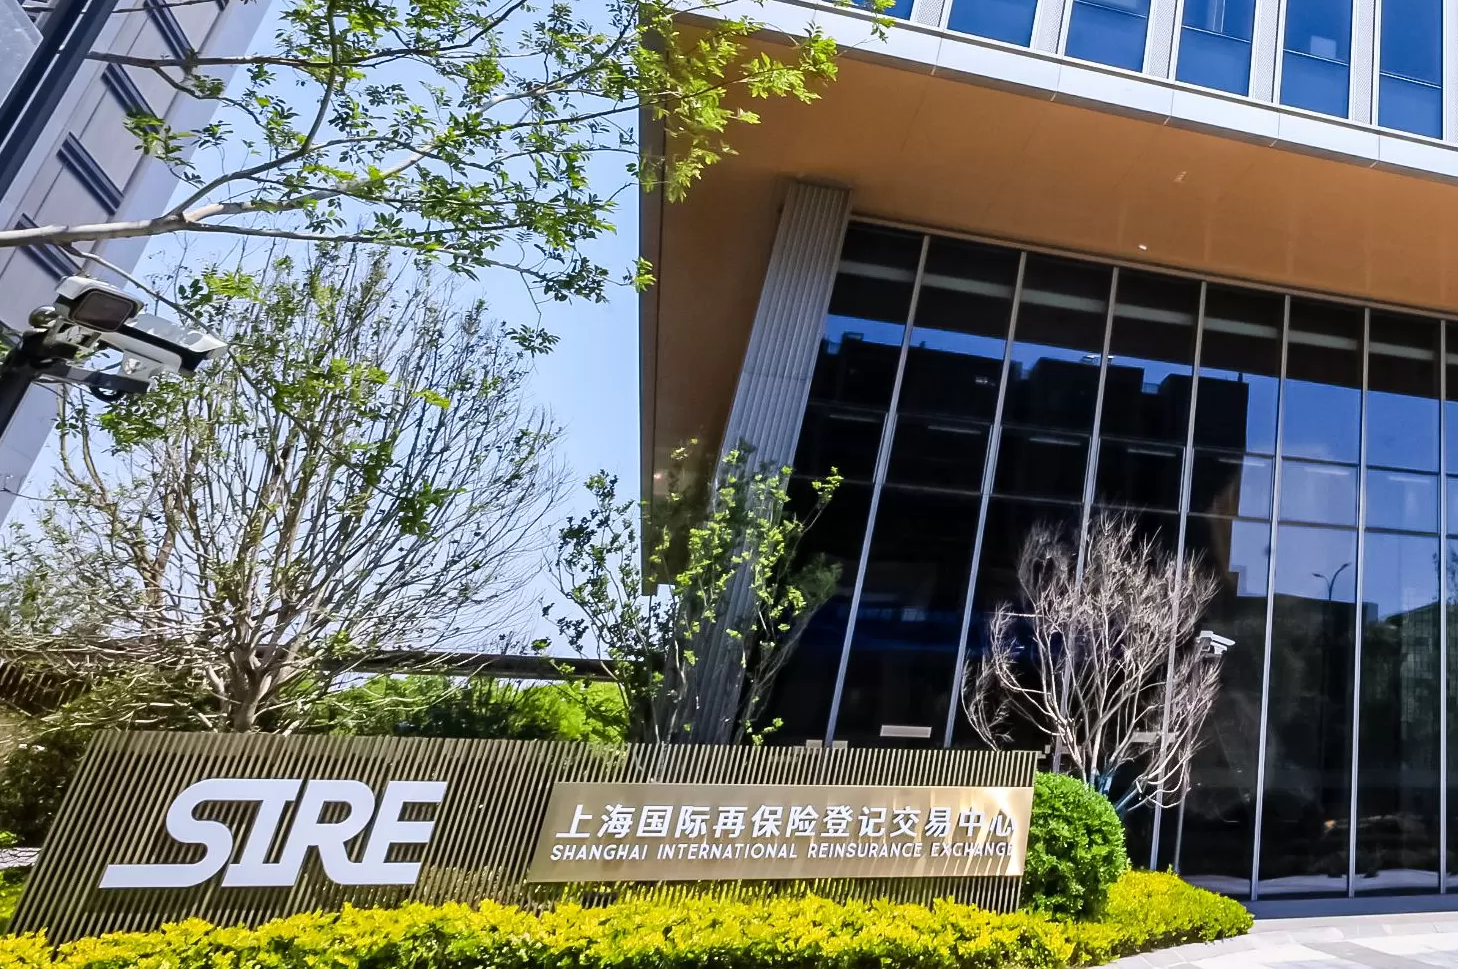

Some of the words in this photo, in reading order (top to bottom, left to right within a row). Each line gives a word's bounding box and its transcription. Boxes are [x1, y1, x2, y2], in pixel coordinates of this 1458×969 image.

[556, 804, 1015, 838] 上海国际再保险登记交易中心
[550, 843, 647, 861] SHANGHAI
[656, 842, 798, 860] INTERNATIONAL
[807, 842, 922, 859] REINSURANCE
[930, 842, 1014, 858] EXCHANGE
